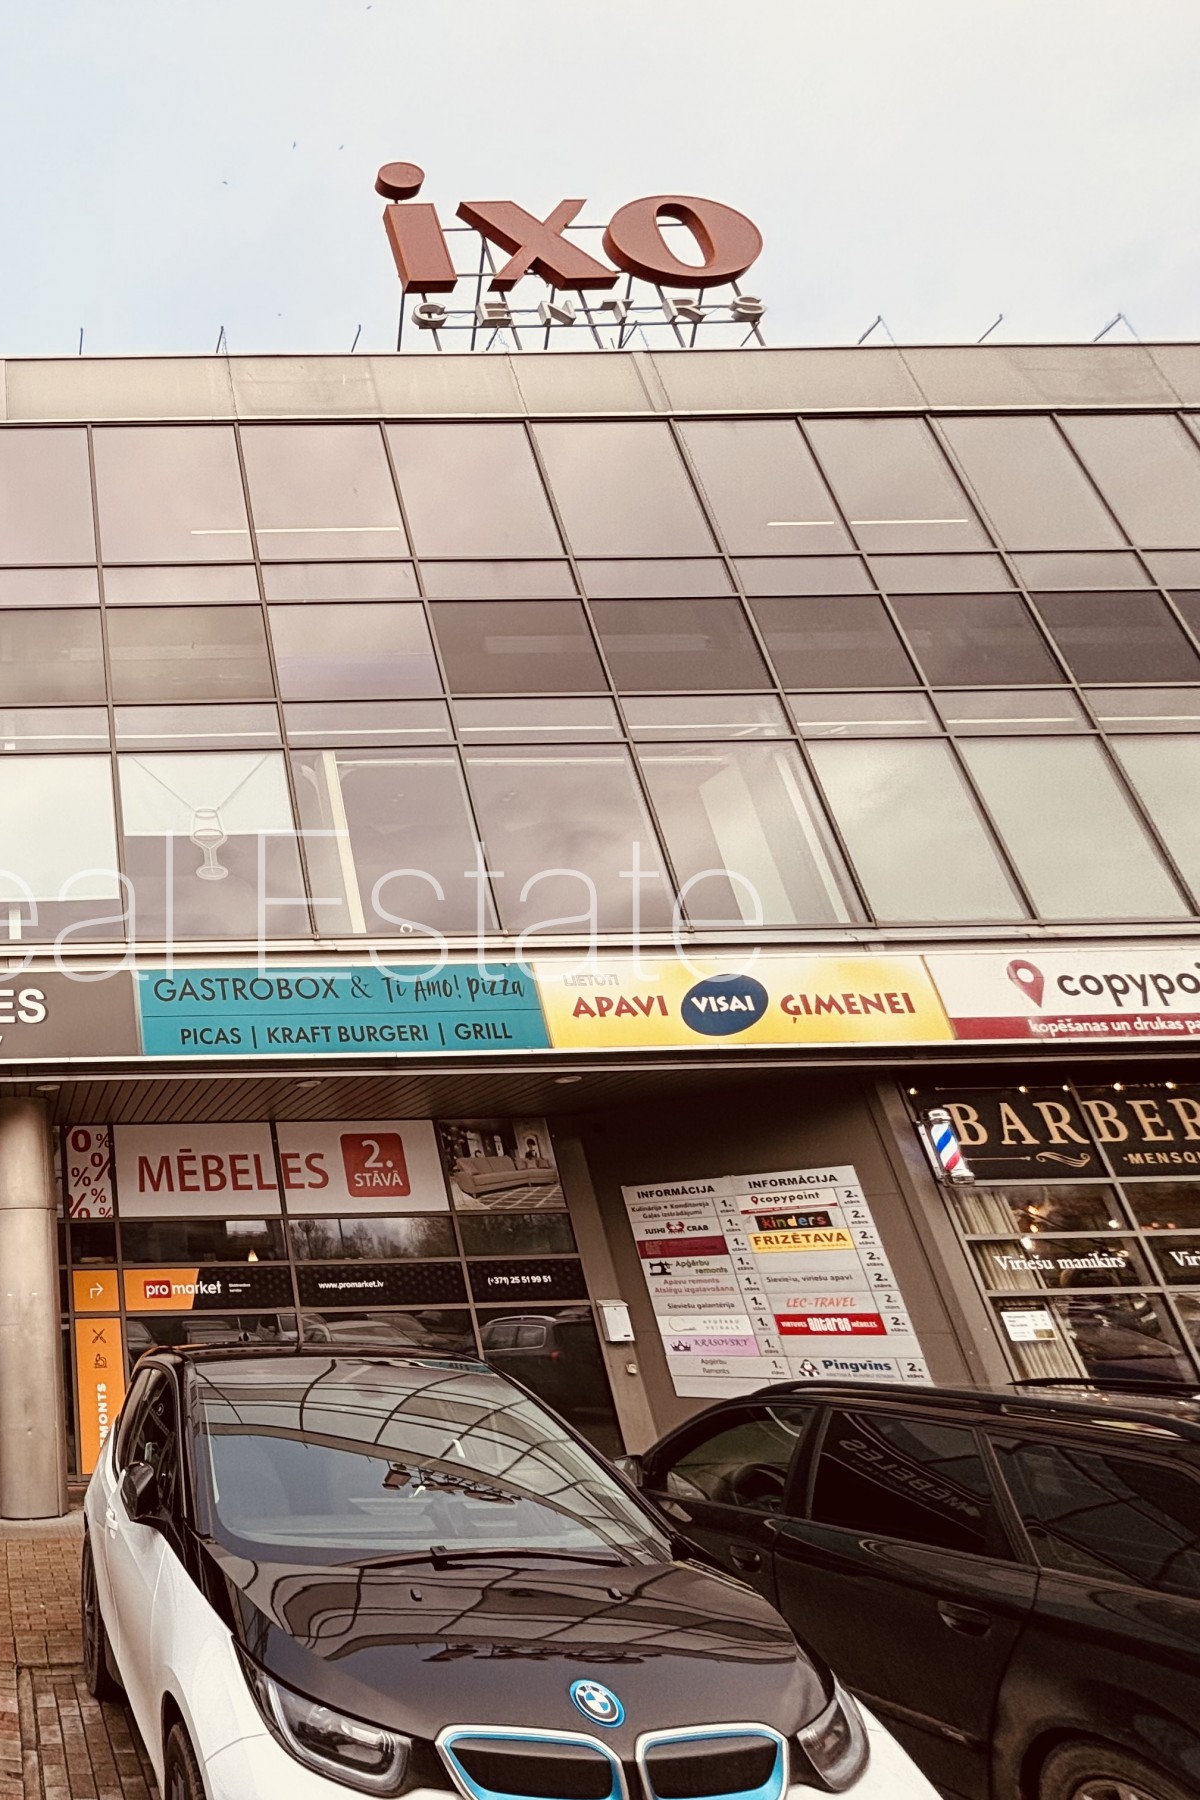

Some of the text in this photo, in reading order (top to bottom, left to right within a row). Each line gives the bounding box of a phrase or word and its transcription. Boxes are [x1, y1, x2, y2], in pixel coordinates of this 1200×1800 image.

[411, 296, 768, 330] CENTRS
[154, 976, 341, 1002] GASTROBOX
[350, 975, 373, 999] &
[1057, 962, 1200, 1007] copypo
[572, 992, 917, 1024] APAVI VISAI ĢIMENEI
[180, 1022, 513, 1045] PICAS KRAFT BURGERI GRILL
[1028, 1018, 1109, 1036] kopēšanas
[1111, 1020, 1131, 1031] un
[1133, 1017, 1184, 1031] drukas
[1127, 1151, 1200, 1164] MENSQ
[138, 1140, 394, 1192] MĒBELES 2.
[354, 1170, 403, 1188] STĀVĀ
[748, 1174, 838, 1189] INFORMĀCIJA
[637, 1185, 715, 1199] INFORMĀCIJA
[760, 1192, 820, 1204] copypoint
[762, 1215, 827, 1229] kinders
[753, 1232, 847, 1246] FRIZĒTAVA
[318, 1280, 384, 1289] www.promarket.lv
[488, 1276, 509, 1285] (+371)
[510, 1276, 520, 1284] 25
[521, 1276, 530, 1284] 51
[543, 1275, 551, 1283] 51
[145, 1284, 169, 1298] pro
[171, 1281, 222, 1294] market
[786, 1297, 856, 1308] LEC-TRAVEL
[821, 1359, 892, 1373] Pingvīns
